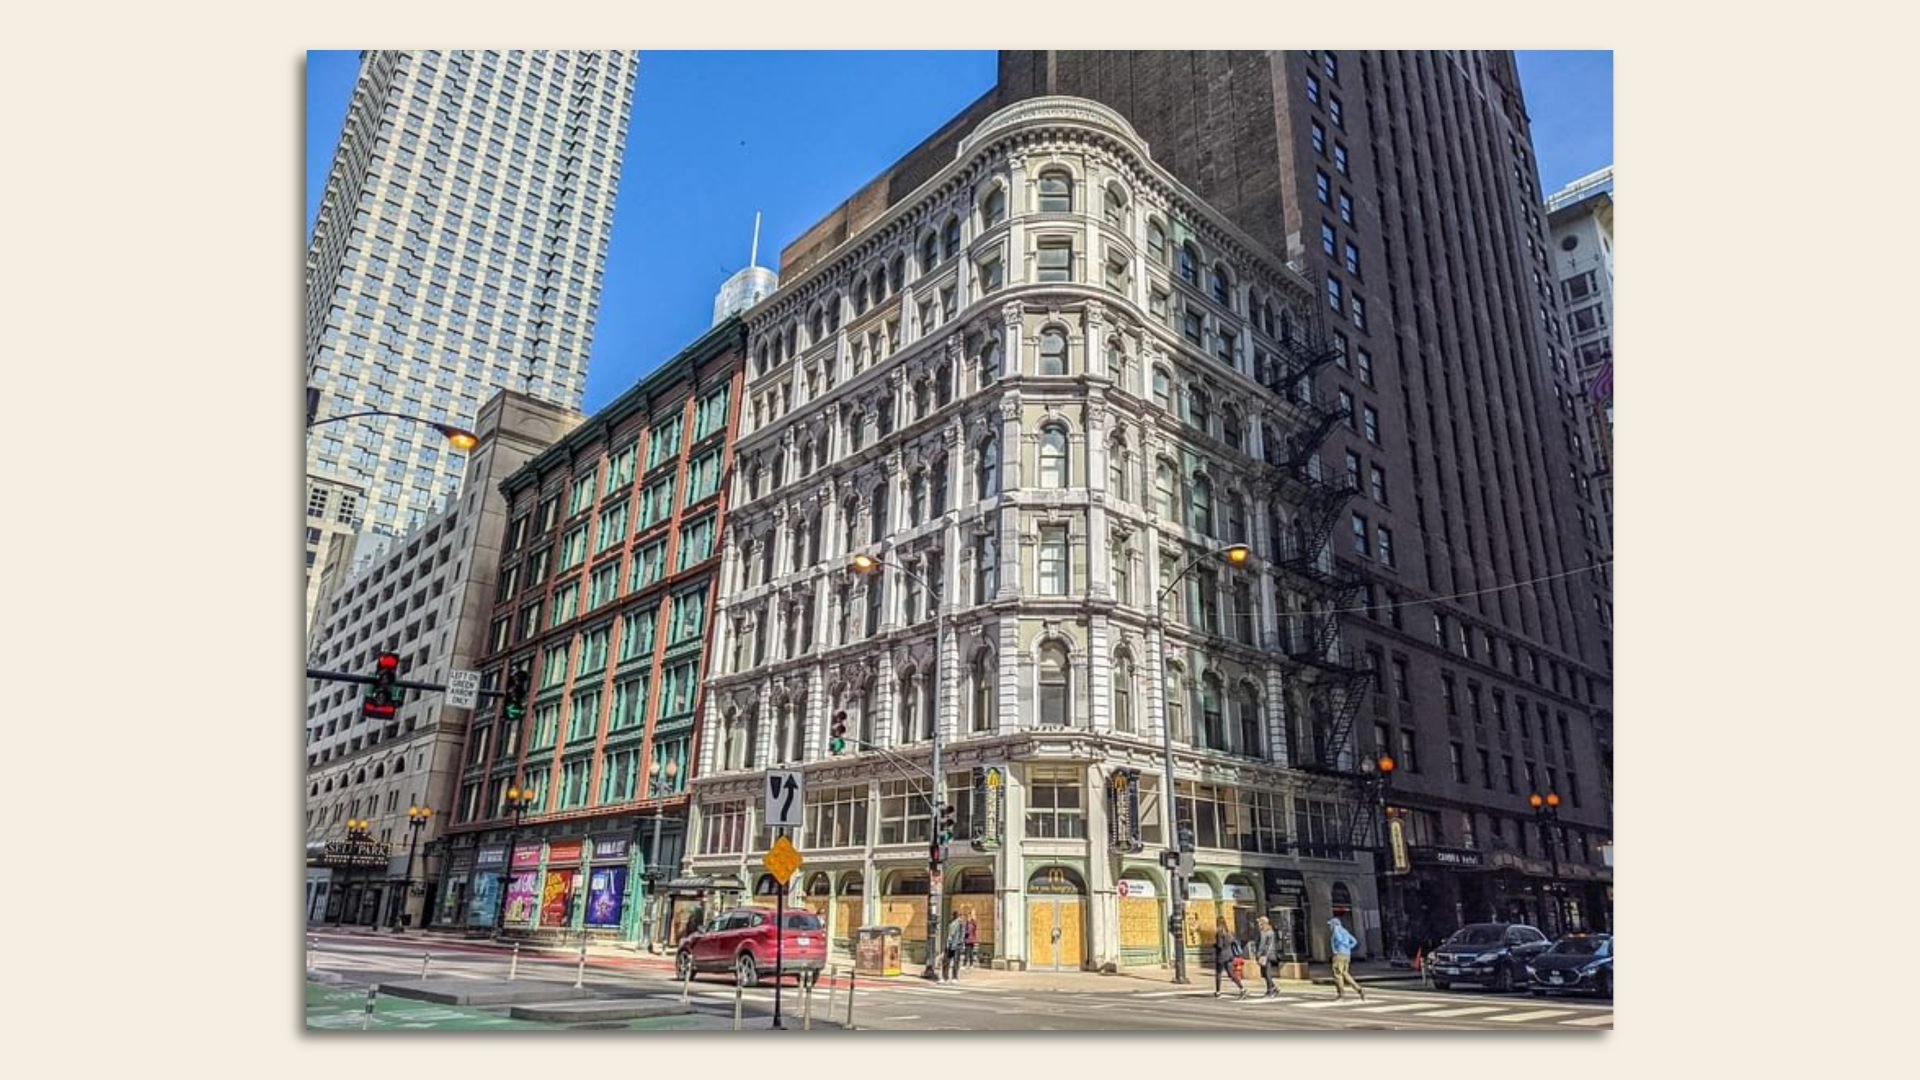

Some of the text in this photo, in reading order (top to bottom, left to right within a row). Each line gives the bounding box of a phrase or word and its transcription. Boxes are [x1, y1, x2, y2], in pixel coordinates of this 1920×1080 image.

[451, 670, 479, 681] LEFT ON
[452, 680, 474, 689] GREEN
[451, 688, 473, 697] ARROW
[452, 696, 469, 705] ONLY
[358, 845, 386, 857] PARK
